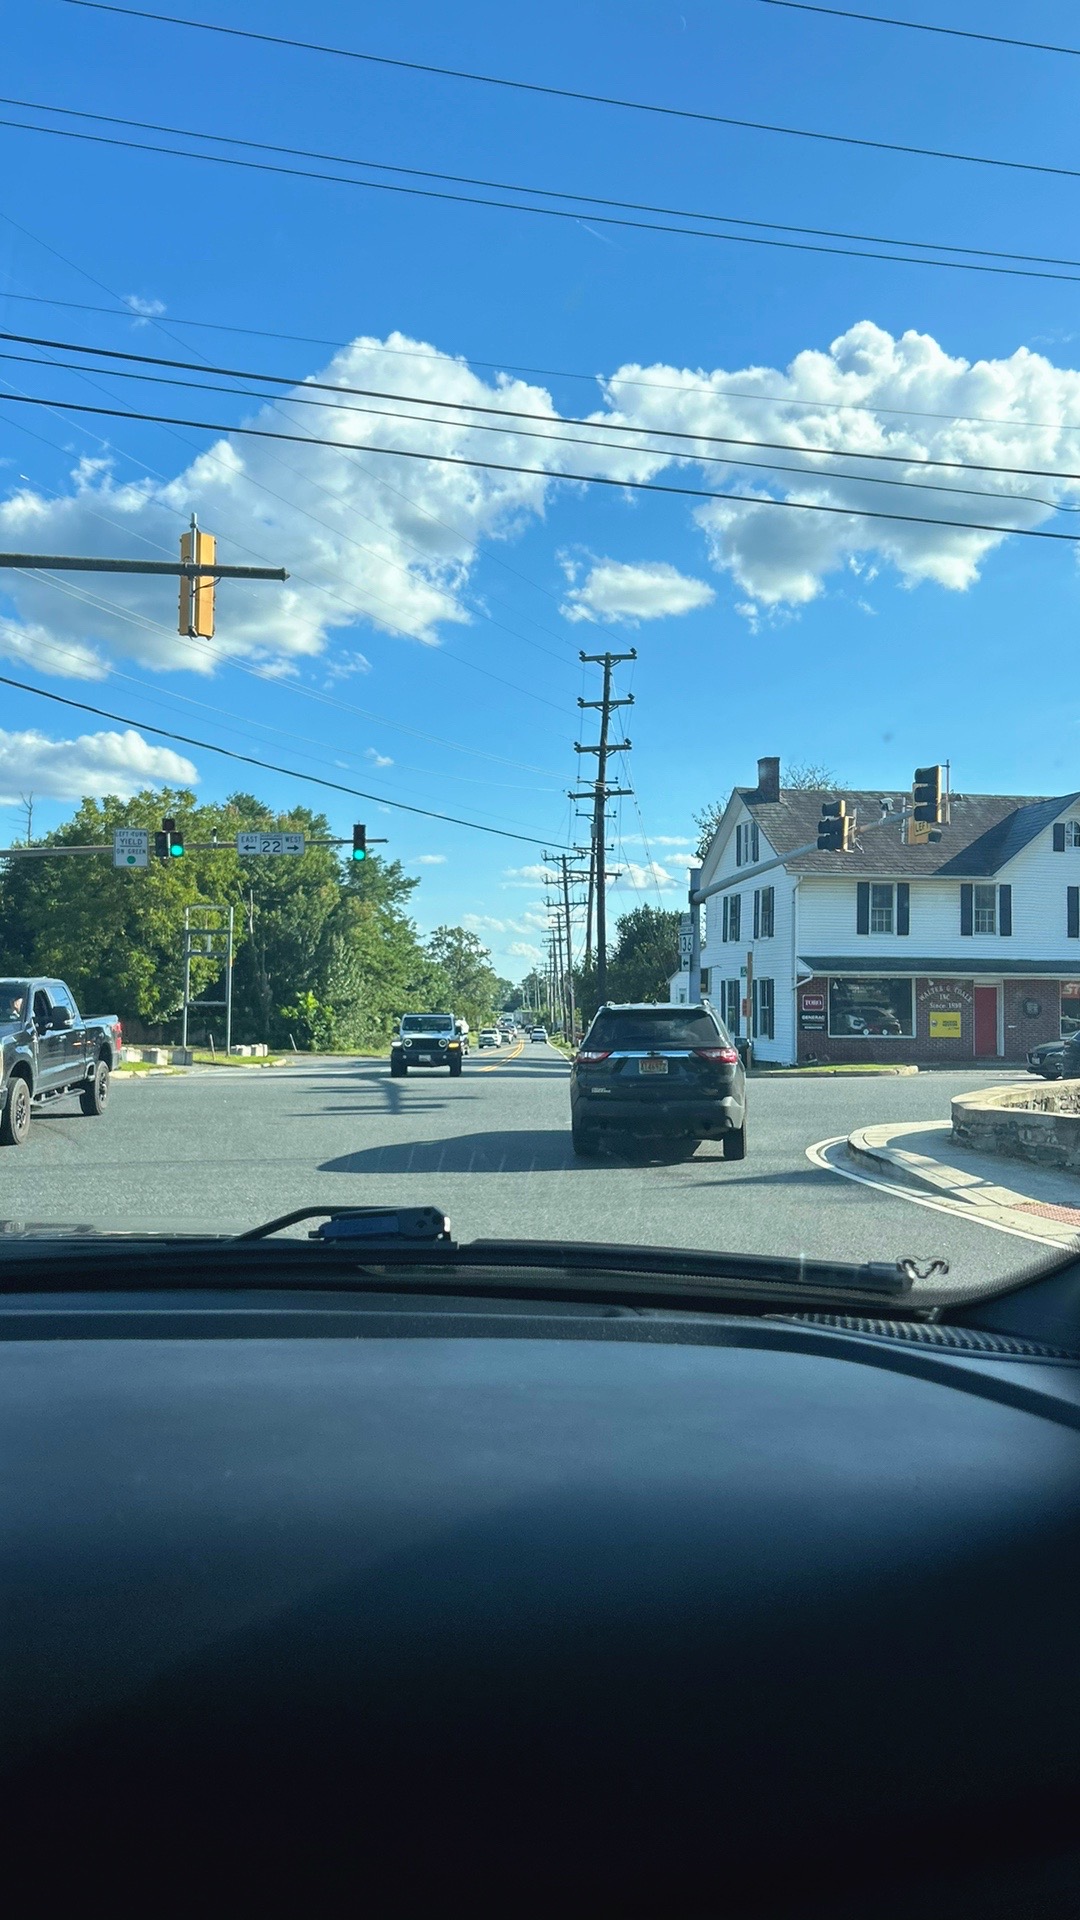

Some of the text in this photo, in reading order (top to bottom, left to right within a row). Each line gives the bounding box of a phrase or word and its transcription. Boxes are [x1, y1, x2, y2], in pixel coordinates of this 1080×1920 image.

[241, 836, 258, 844] EAST
[285, 836, 302, 844] WEST
[262, 840, 281, 853] 22
[680, 936, 692, 952] 136
